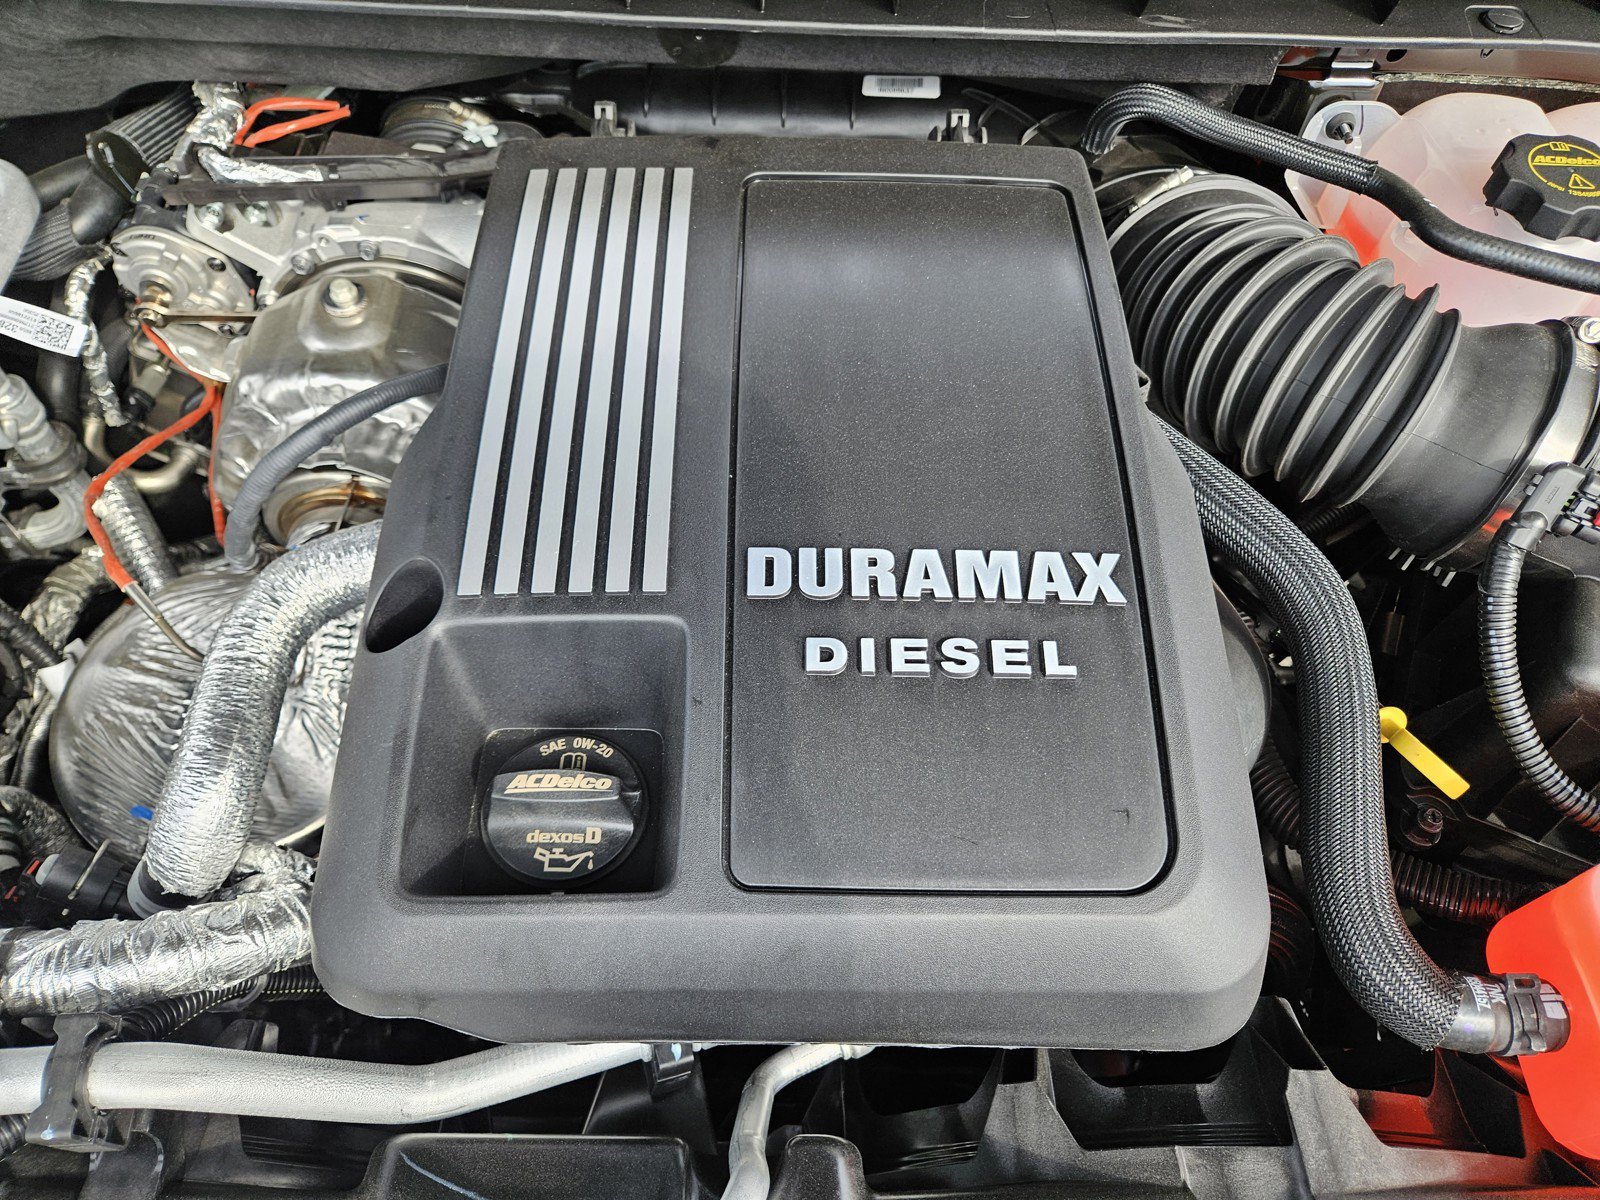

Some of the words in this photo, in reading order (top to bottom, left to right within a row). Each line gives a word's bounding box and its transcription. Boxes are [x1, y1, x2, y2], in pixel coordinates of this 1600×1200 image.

[1533, 155, 1600, 166] ACDelco
[746, 546, 1128, 606] DURAMAX
[805, 637, 1078, 679] DIESEL
[539, 738, 567, 756] SAE
[572, 737, 614, 758] 0W-20
[505, 773, 613, 791] ACDelco
